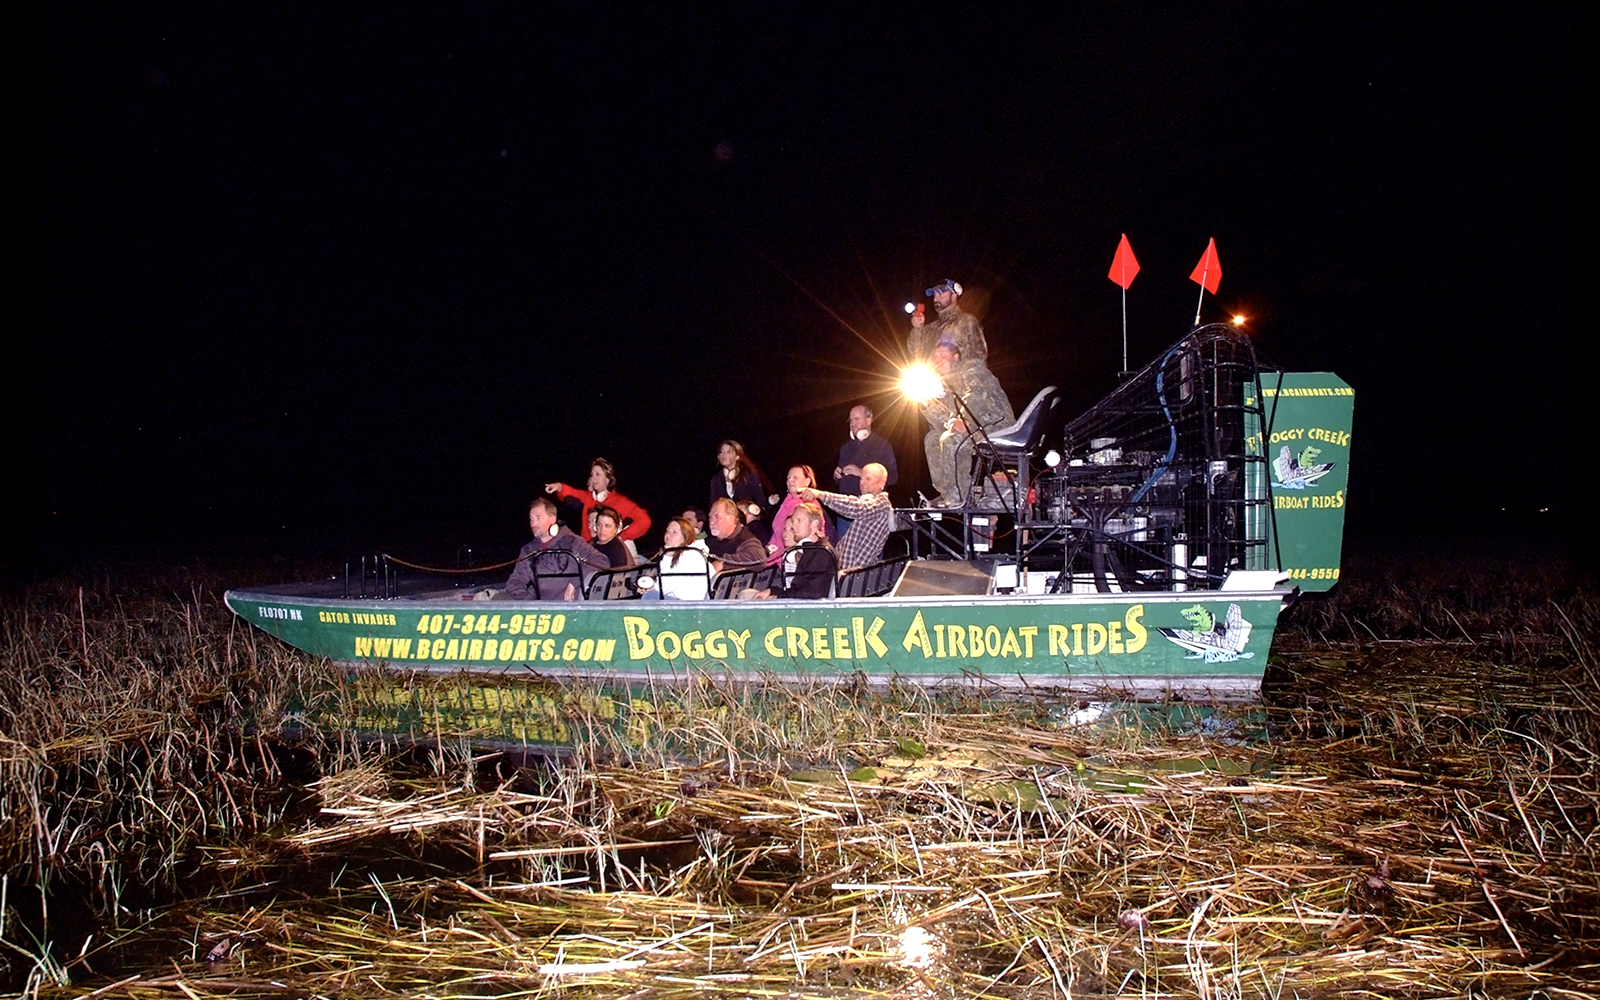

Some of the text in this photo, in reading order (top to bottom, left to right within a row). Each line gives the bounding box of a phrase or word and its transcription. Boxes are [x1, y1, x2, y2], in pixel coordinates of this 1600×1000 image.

[1259, 428, 1304, 445] OGGY
[1308, 427, 1351, 447] CREEK
[1273, 490, 1344, 509] IRBOAT RIDES
[289, 609, 304, 621] NK
[318, 611, 397, 627] GATOR INVADER
[416, 614, 566, 635] 407-344-9550
[622, 604, 1149, 661] BOGGY CREEK AIRBOAT RIDES
[354, 637, 616, 662] WWW.BCAIRBOATS.COM
